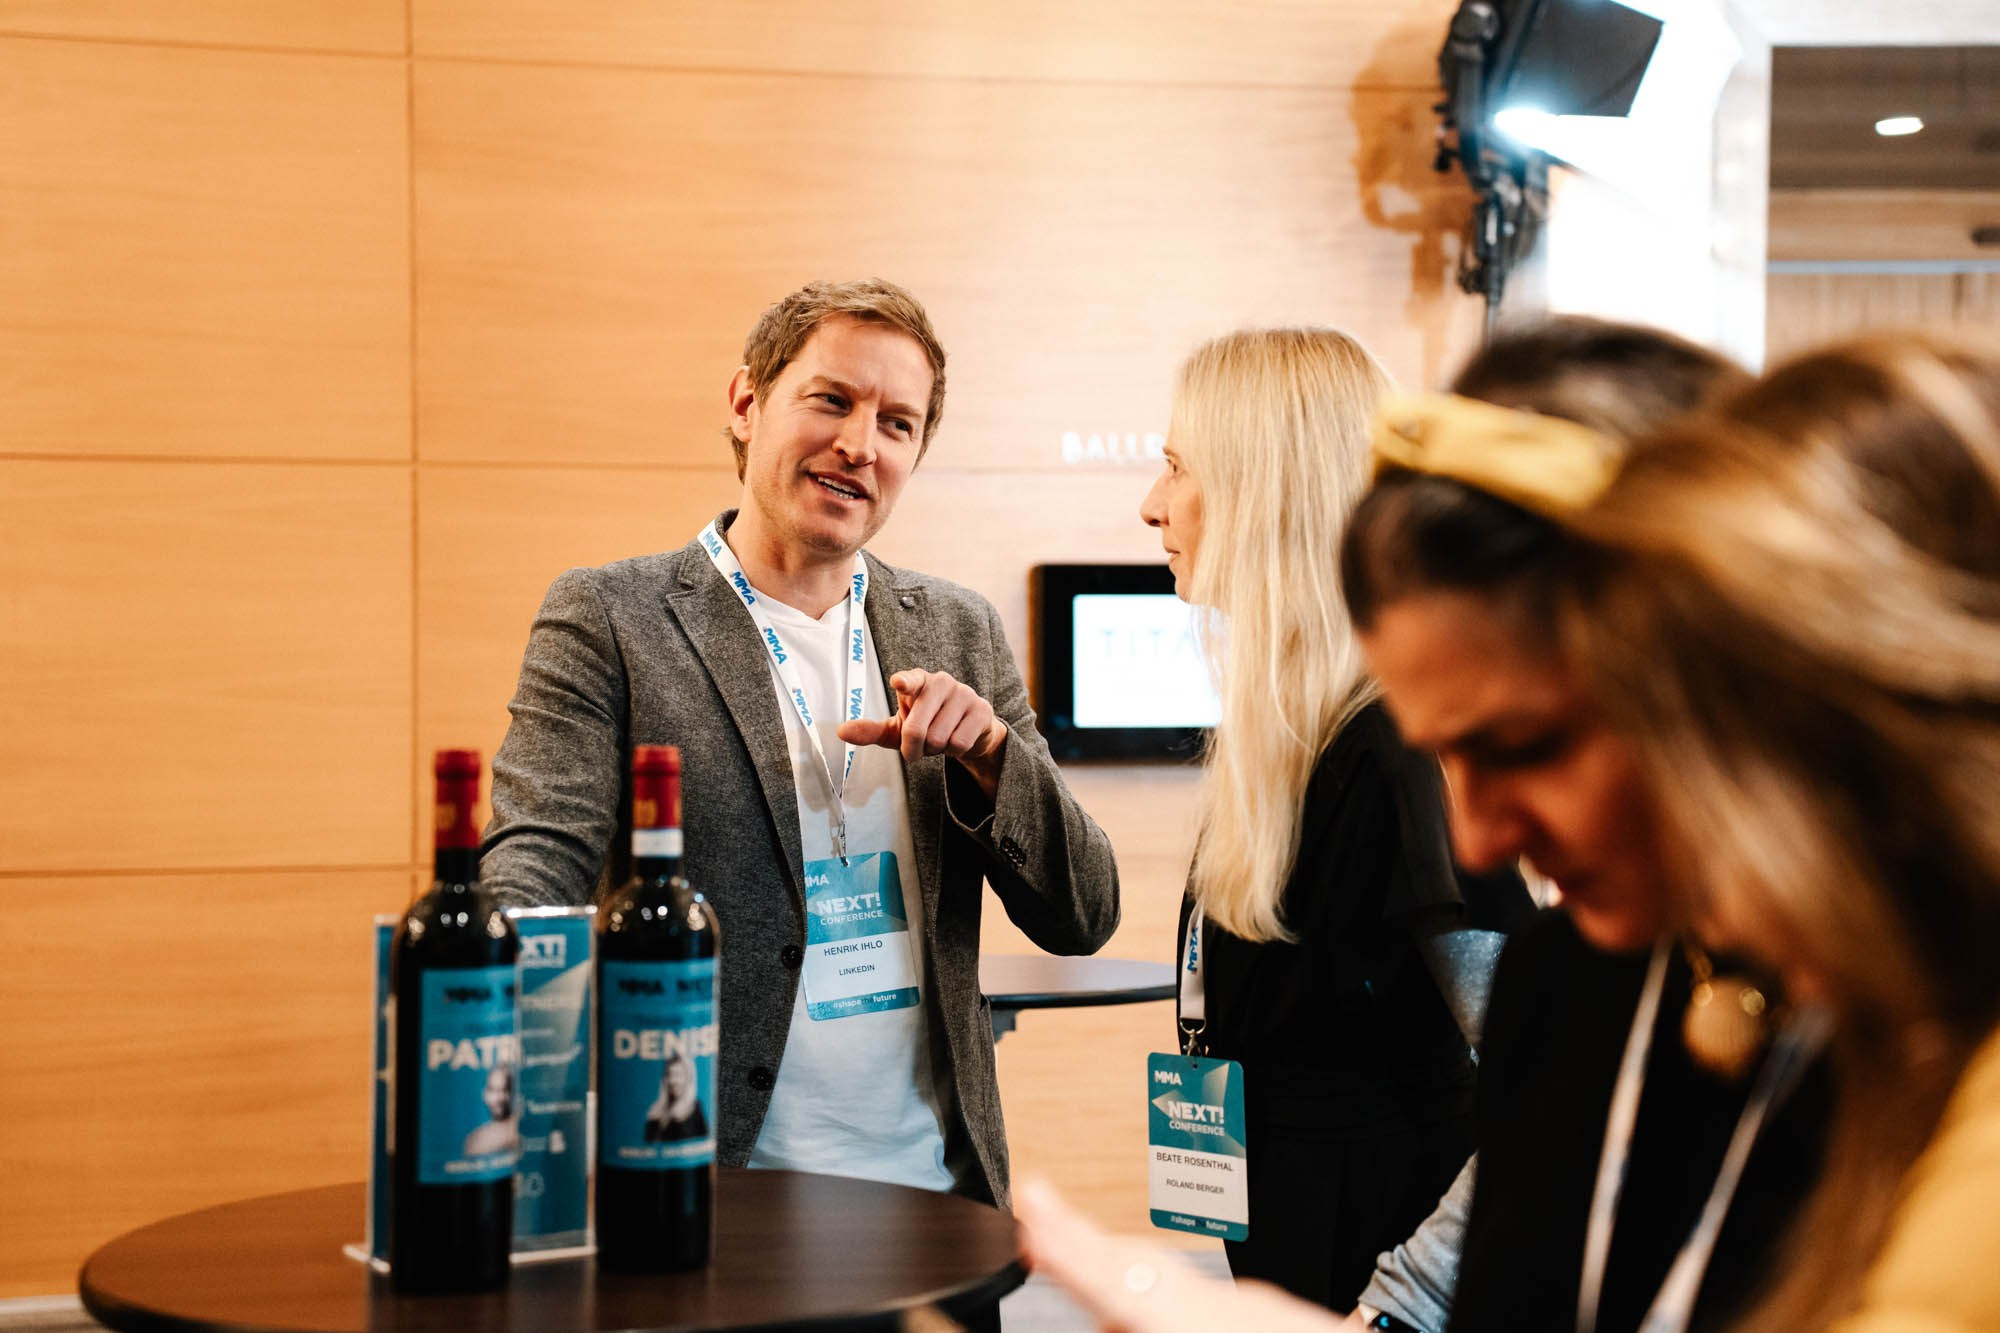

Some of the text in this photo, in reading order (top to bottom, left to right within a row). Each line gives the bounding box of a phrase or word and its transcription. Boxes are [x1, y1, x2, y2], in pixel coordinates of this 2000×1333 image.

[703, 531, 722, 558] MMA
[731, 571, 756, 605] MMA
[852, 573, 864, 603] MMA
[764, 627, 788, 664] MMA
[852, 629, 863, 663] MMA
[792, 688, 813, 726] MMA
[816, 892, 882, 915] NEXT!
[820, 909, 884, 926] CONFERENCE
[824, 940, 883, 956] HENRIK IHLO
[839, 964, 875, 976] LINKEDIN
[873, 994, 896, 1003] future
[1154, 1070, 1182, 1086] MMA
[1168, 1100, 1224, 1124] NEXT!
[1169, 1120, 1225, 1136] CONFERENCE
[1156, 1152, 1233, 1171] BEATE ROSENTHAL
[1166, 1179, 1224, 1194] ROLAND BERGER
